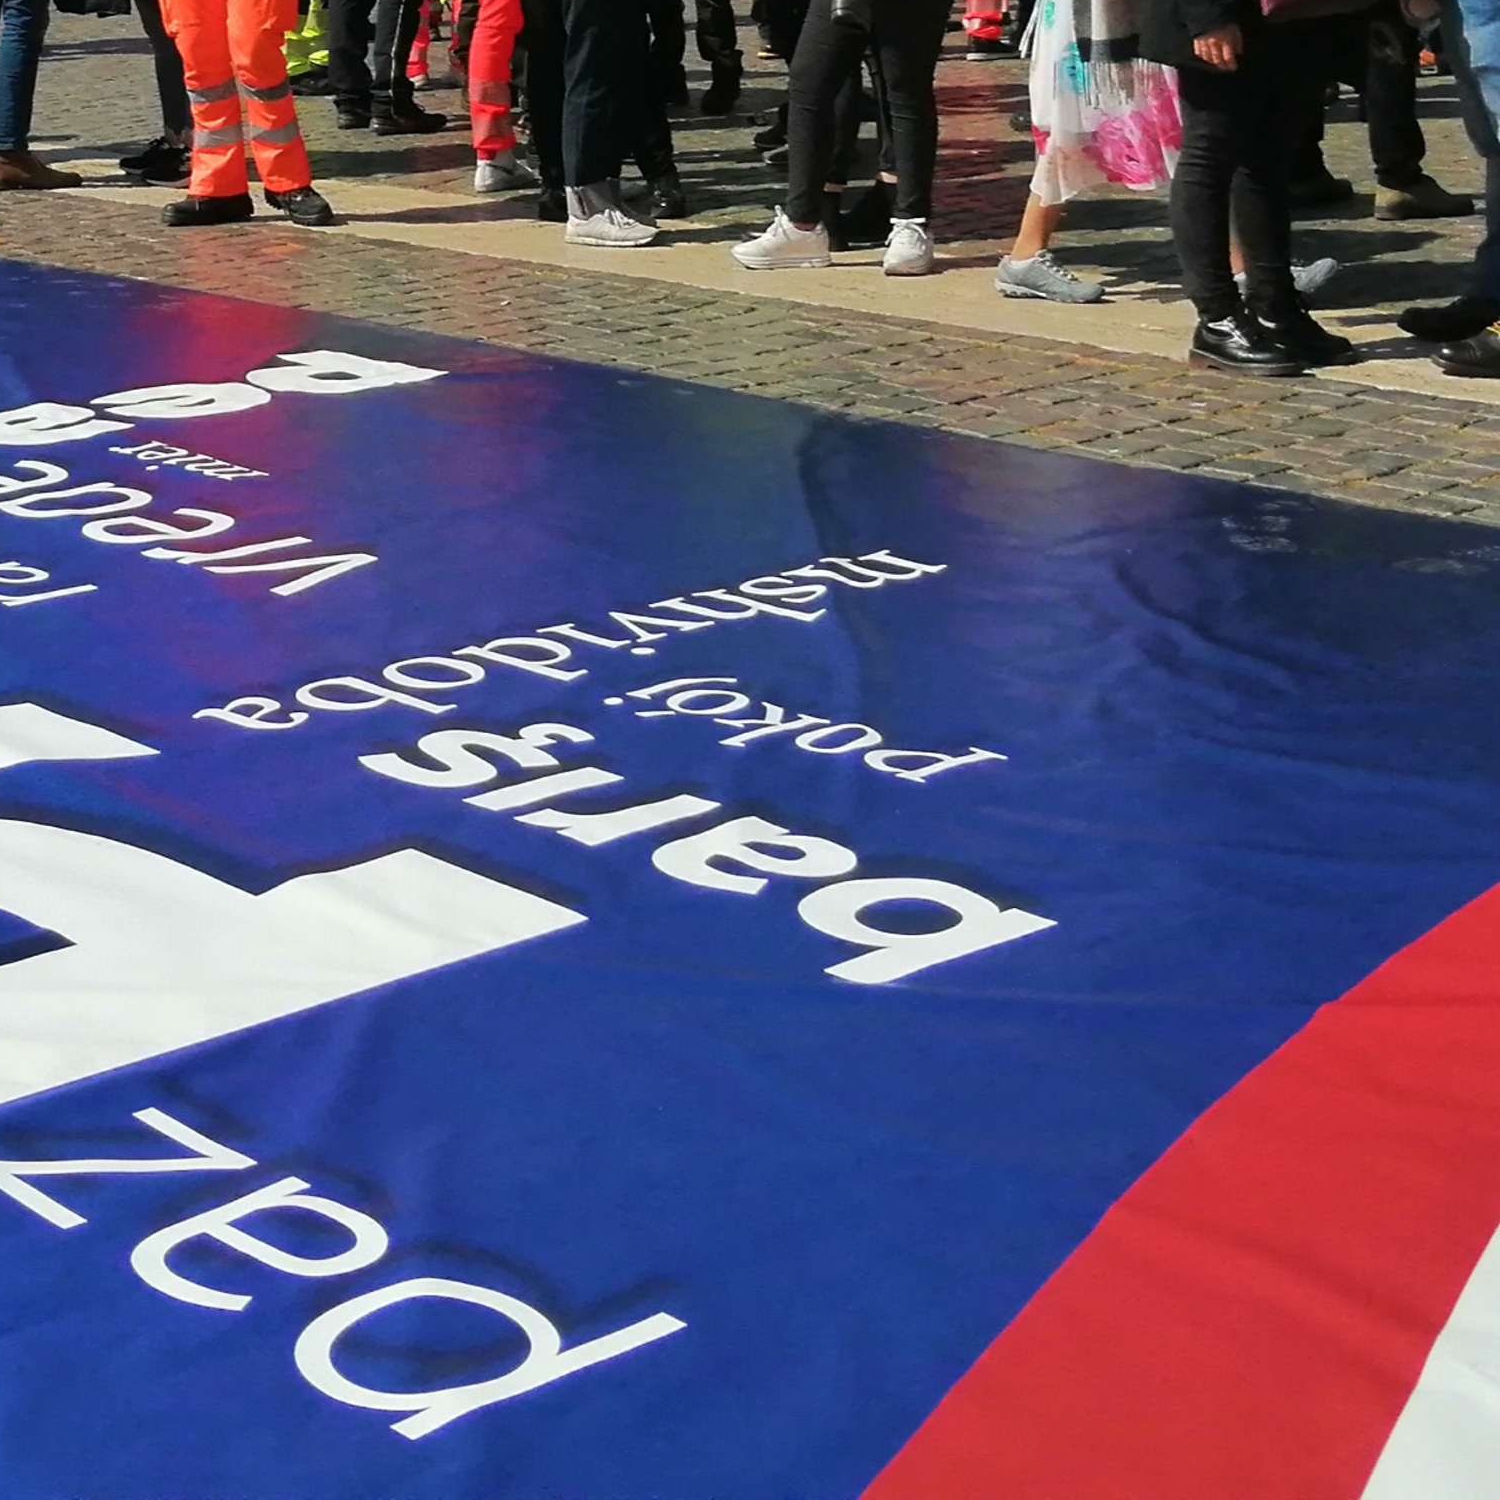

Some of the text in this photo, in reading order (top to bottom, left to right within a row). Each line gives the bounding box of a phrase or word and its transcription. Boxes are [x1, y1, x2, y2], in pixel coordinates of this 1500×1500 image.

[108, 440, 270, 481] mier
[191, 549, 948, 729] mshvidoba
[603, 677, 1008, 782] pokój
